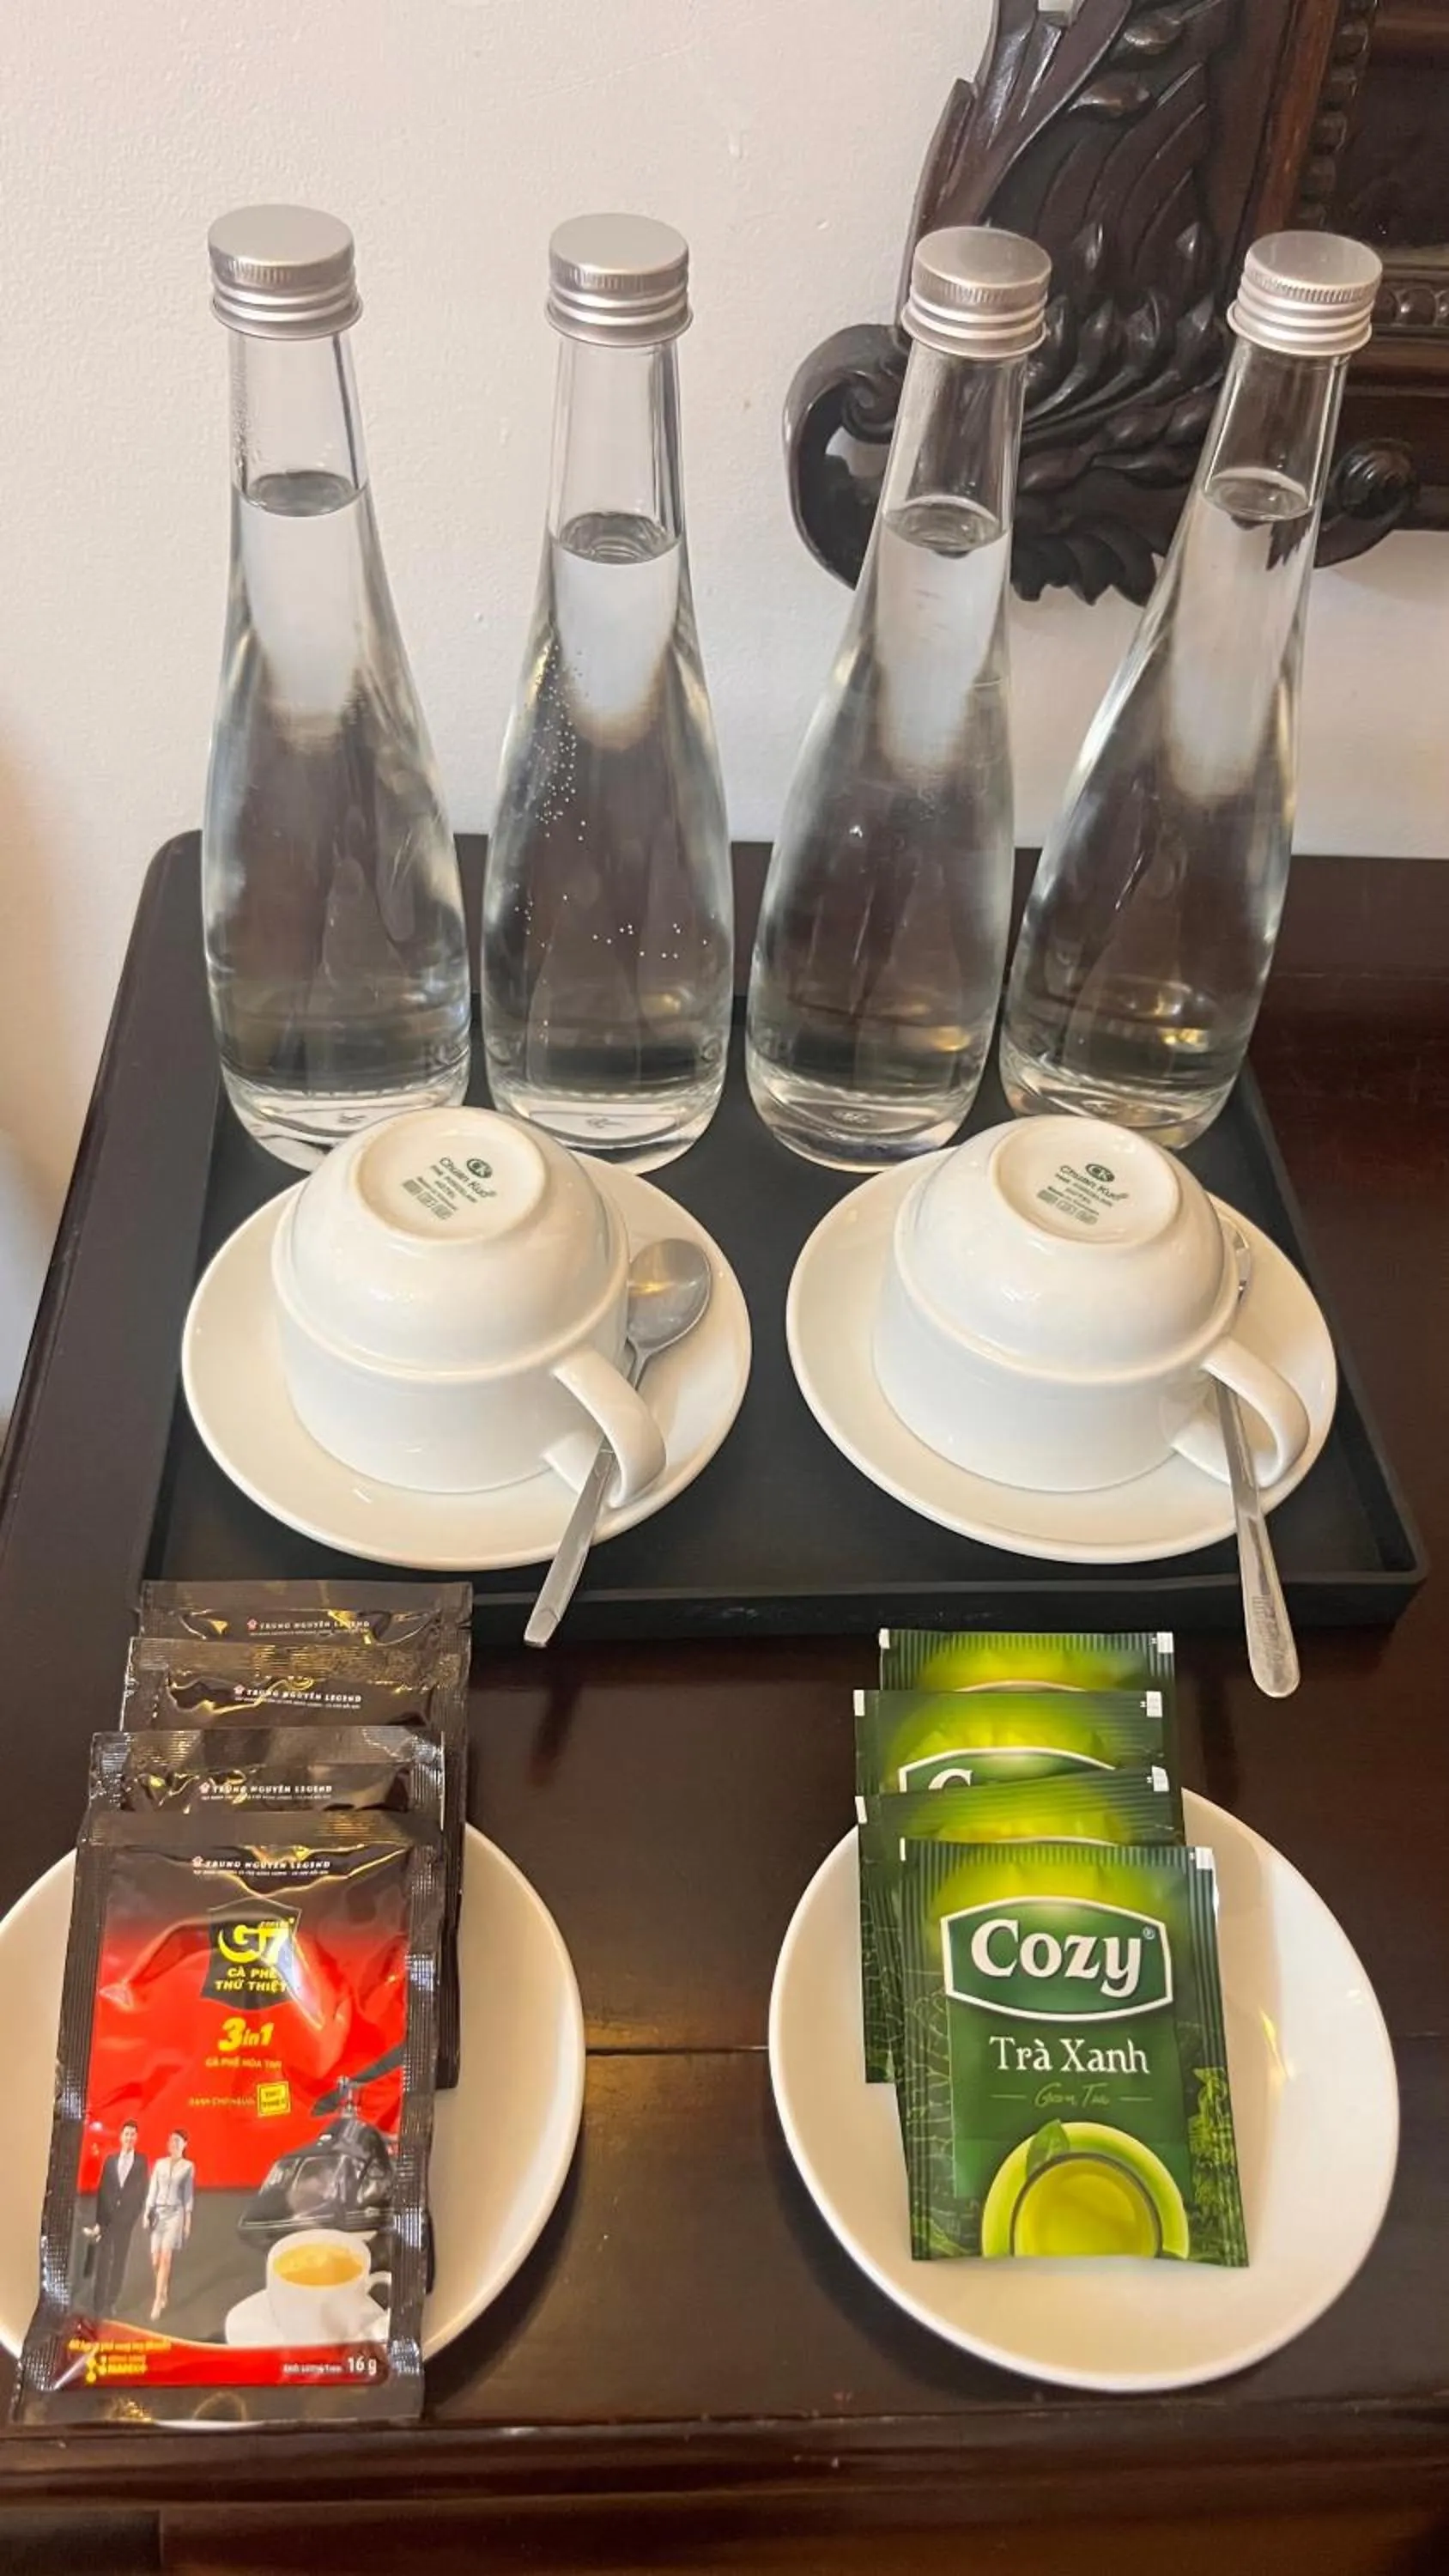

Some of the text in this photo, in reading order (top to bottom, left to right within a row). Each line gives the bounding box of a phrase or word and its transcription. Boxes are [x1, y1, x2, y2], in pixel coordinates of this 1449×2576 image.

[440, 1157, 470, 1182] Chuan
[1060, 1165, 1096, 1188] Chuan
[325, 1693, 361, 1702] LEGEND
[290, 1860, 330, 1869] LEGEND
[218, 1924, 289, 1965] G7
[971, 1918, 1142, 1998] Cozy
[227, 1965, 246, 1978] CÀ
[217, 2016, 275, 2051] 3in1
[989, 2035, 1151, 2075] Trà Xanh
[348, 2355, 365, 2373] 16
[368, 2358, 377, 2376] g
